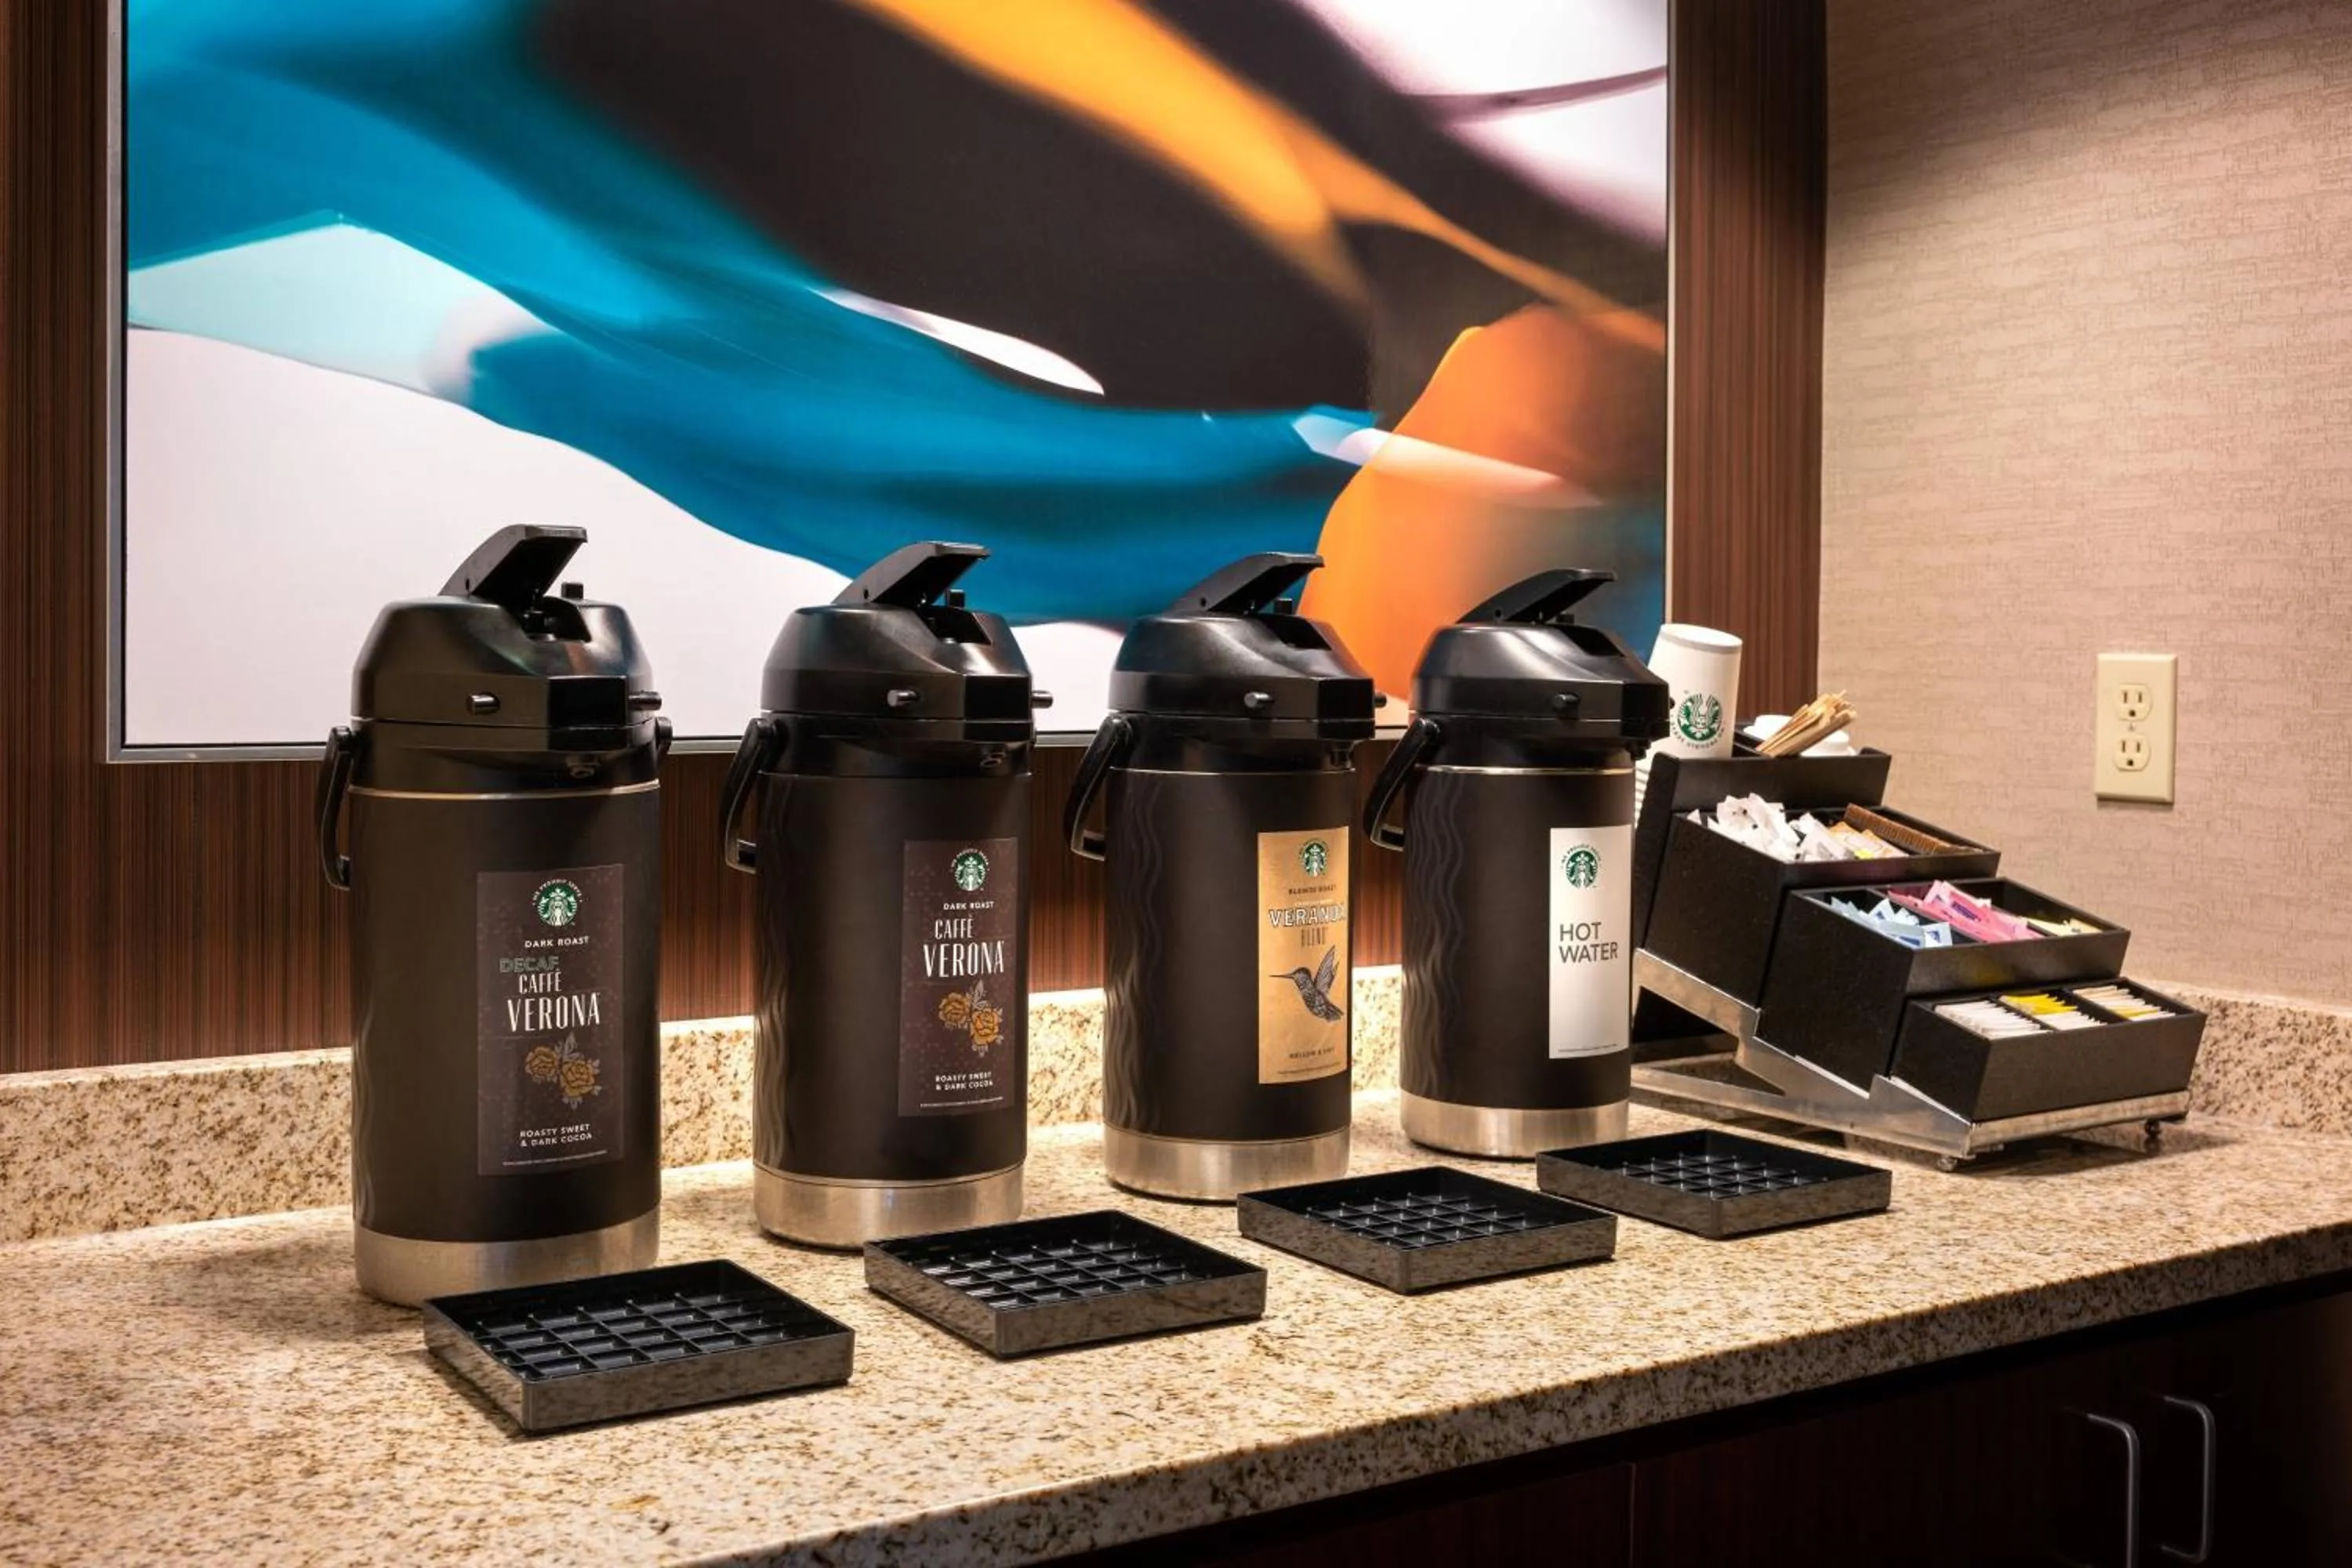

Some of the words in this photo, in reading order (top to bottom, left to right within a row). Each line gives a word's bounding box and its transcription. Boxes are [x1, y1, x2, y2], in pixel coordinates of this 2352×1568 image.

[557, 936, 590, 946] ROAST
[1559, 922, 1601, 942] HOT
[923, 941, 1004, 978] VERONA
[1559, 942, 1618, 964] WATER
[499, 956, 559, 972] DECAF
[507, 993, 601, 1032] VERONA
[520, 1128, 557, 1138] ROASTY
[561, 1124, 590, 1134] SWEET
[561, 1133, 592, 1143] COCOA
